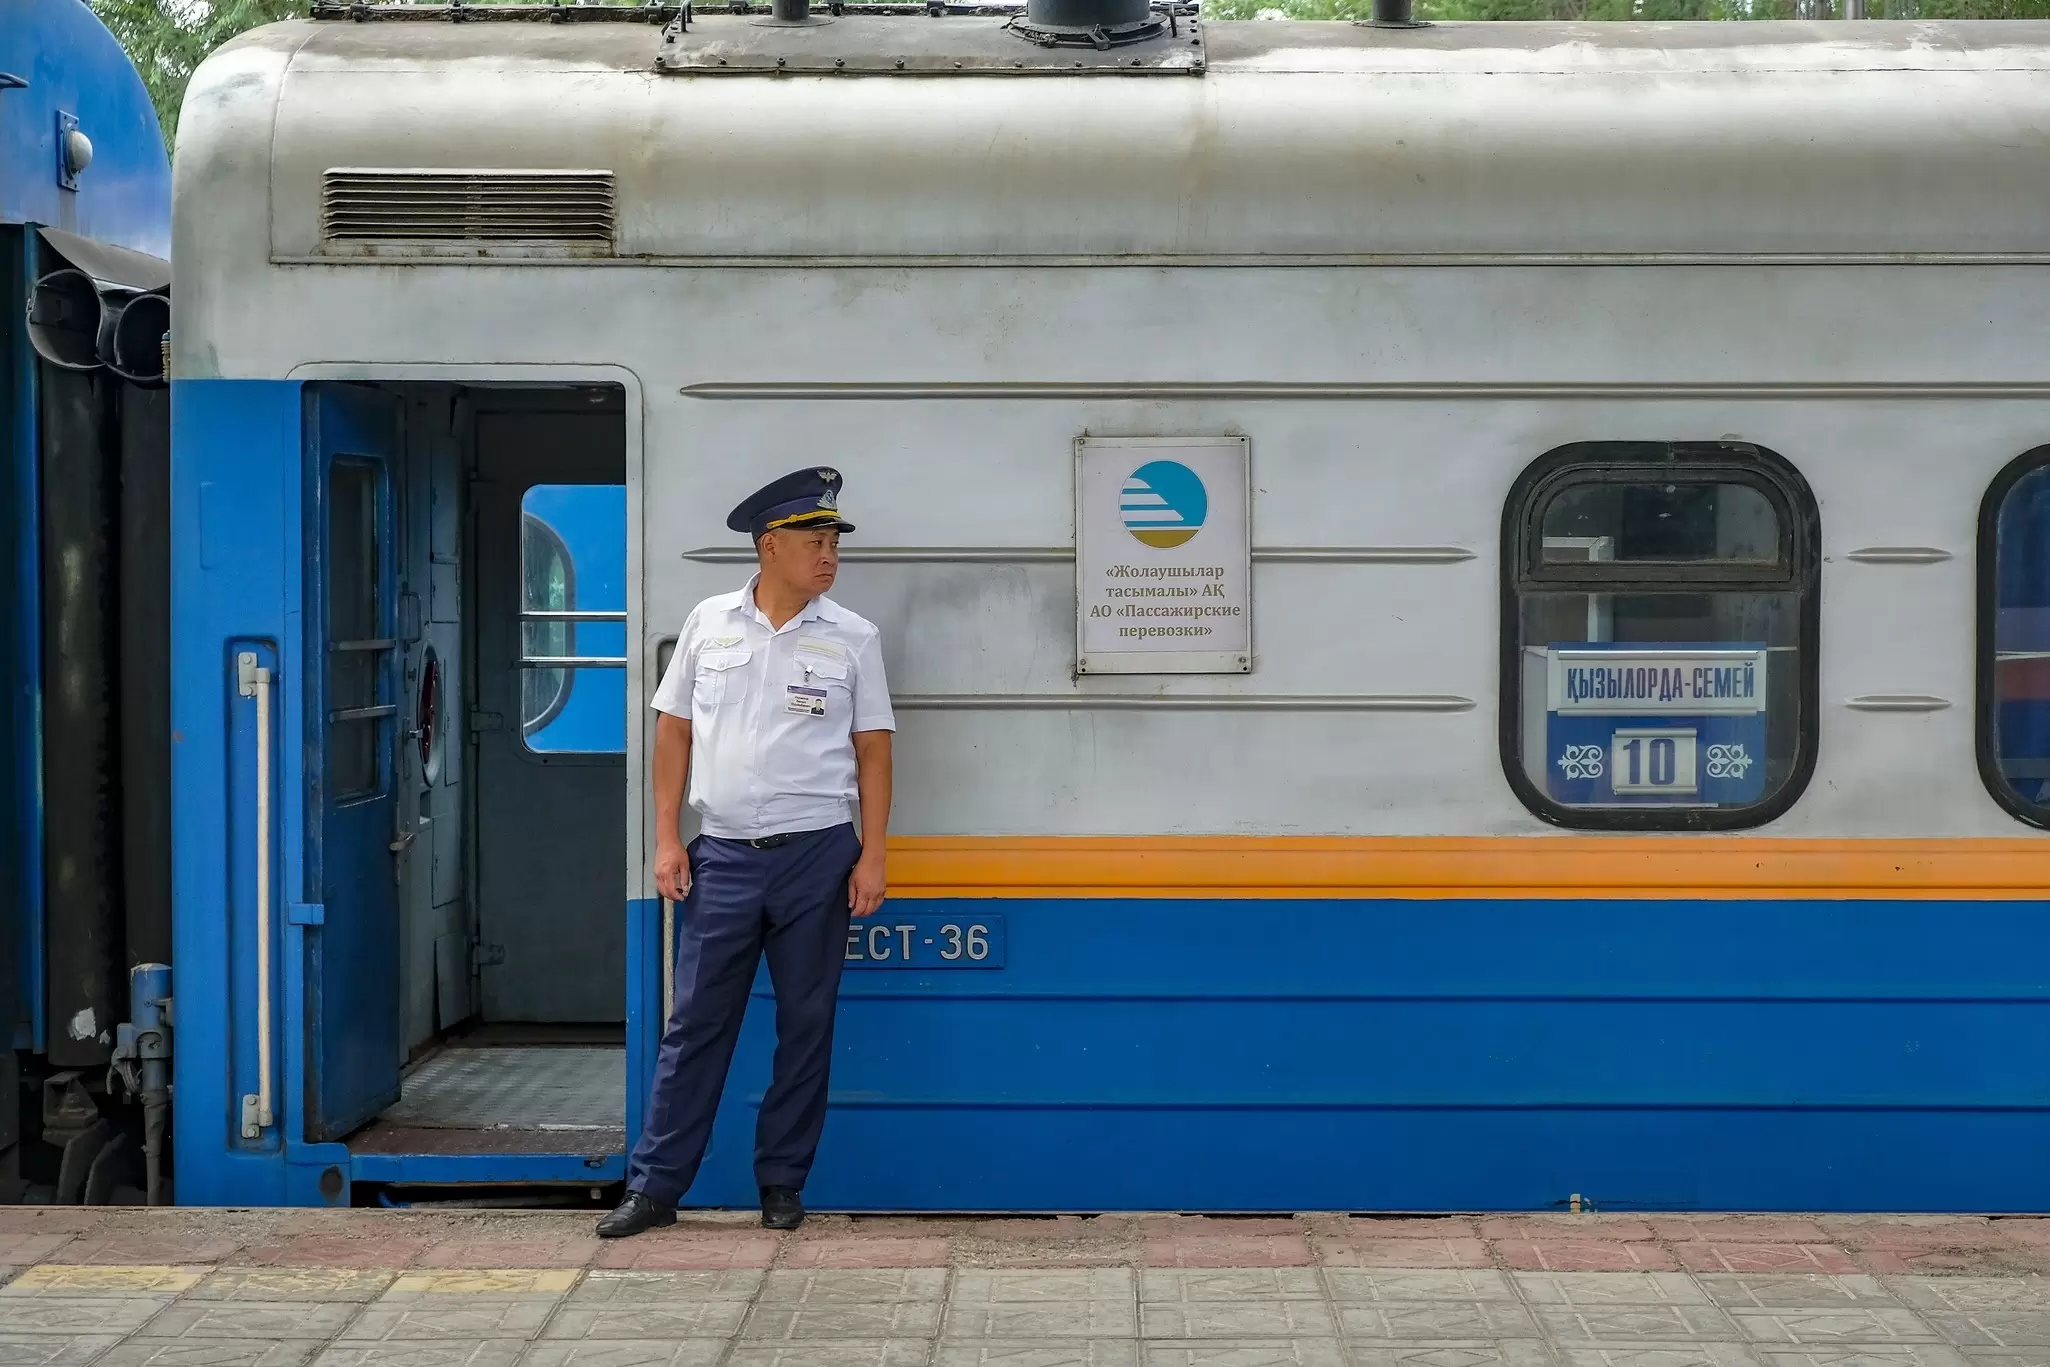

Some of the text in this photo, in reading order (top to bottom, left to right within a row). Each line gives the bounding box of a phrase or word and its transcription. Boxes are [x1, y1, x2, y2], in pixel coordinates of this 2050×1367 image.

[1105, 564, 1225, 580] «Жолаушылар
[1105, 584, 1225, 599] тасымалы» АҚ
[1090, 604, 1241, 620] АО «Пассажирские
[1119, 625, 1213, 640] перевозки»
[1567, 662, 1754, 704] ҚЫЗЫЛОРДА-СЕМЕЙ
[1623, 737, 1676, 786] 10
